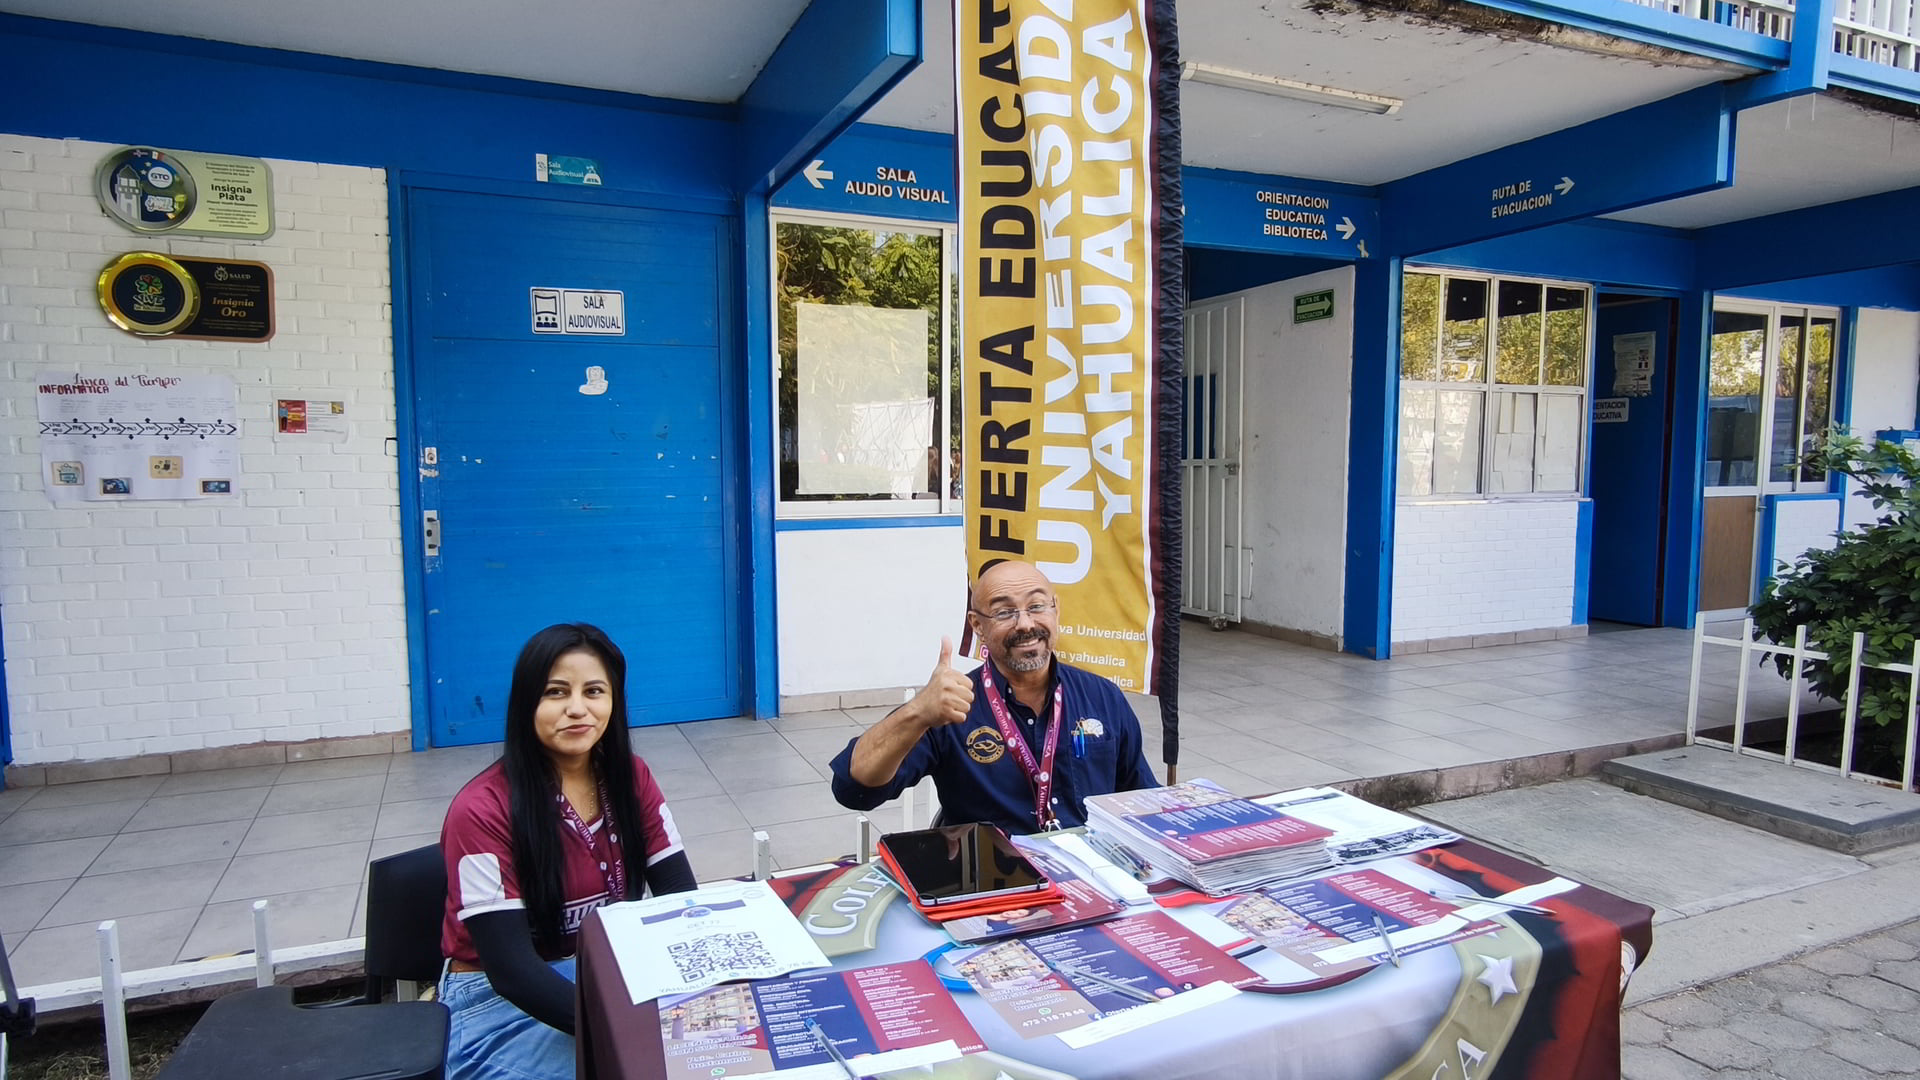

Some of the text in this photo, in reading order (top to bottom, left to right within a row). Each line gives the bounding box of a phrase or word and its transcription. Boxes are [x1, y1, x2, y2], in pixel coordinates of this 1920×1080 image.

[876, 166, 917, 184] SALA
[211, 184, 253, 195] Insignia
[219, 192, 246, 202] Plata
[845, 180, 950, 204] AUDIO VISUAL
[1492, 180, 1532, 201] RUTA DE
[1256, 190, 1330, 210] ORIENTACION
[1491, 193, 1553, 219] EVACUACION
[1265, 208, 1326, 226] EDUCATIVA
[1263, 223, 1328, 241] BIBLIOTECA
[1080, 8, 1134, 531] YAHUALICA
[212, 296, 255, 308] Insignia
[583, 295, 605, 309] SALA
[220, 306, 247, 318] Oro
[568, 314, 622, 330] AUDIOVISUAL
[115, 376, 129, 387] del
[978, 325, 1035, 580] FERTA
[1077, 624, 1146, 642] Universidad
[1069, 651, 1126, 667] yahualica
